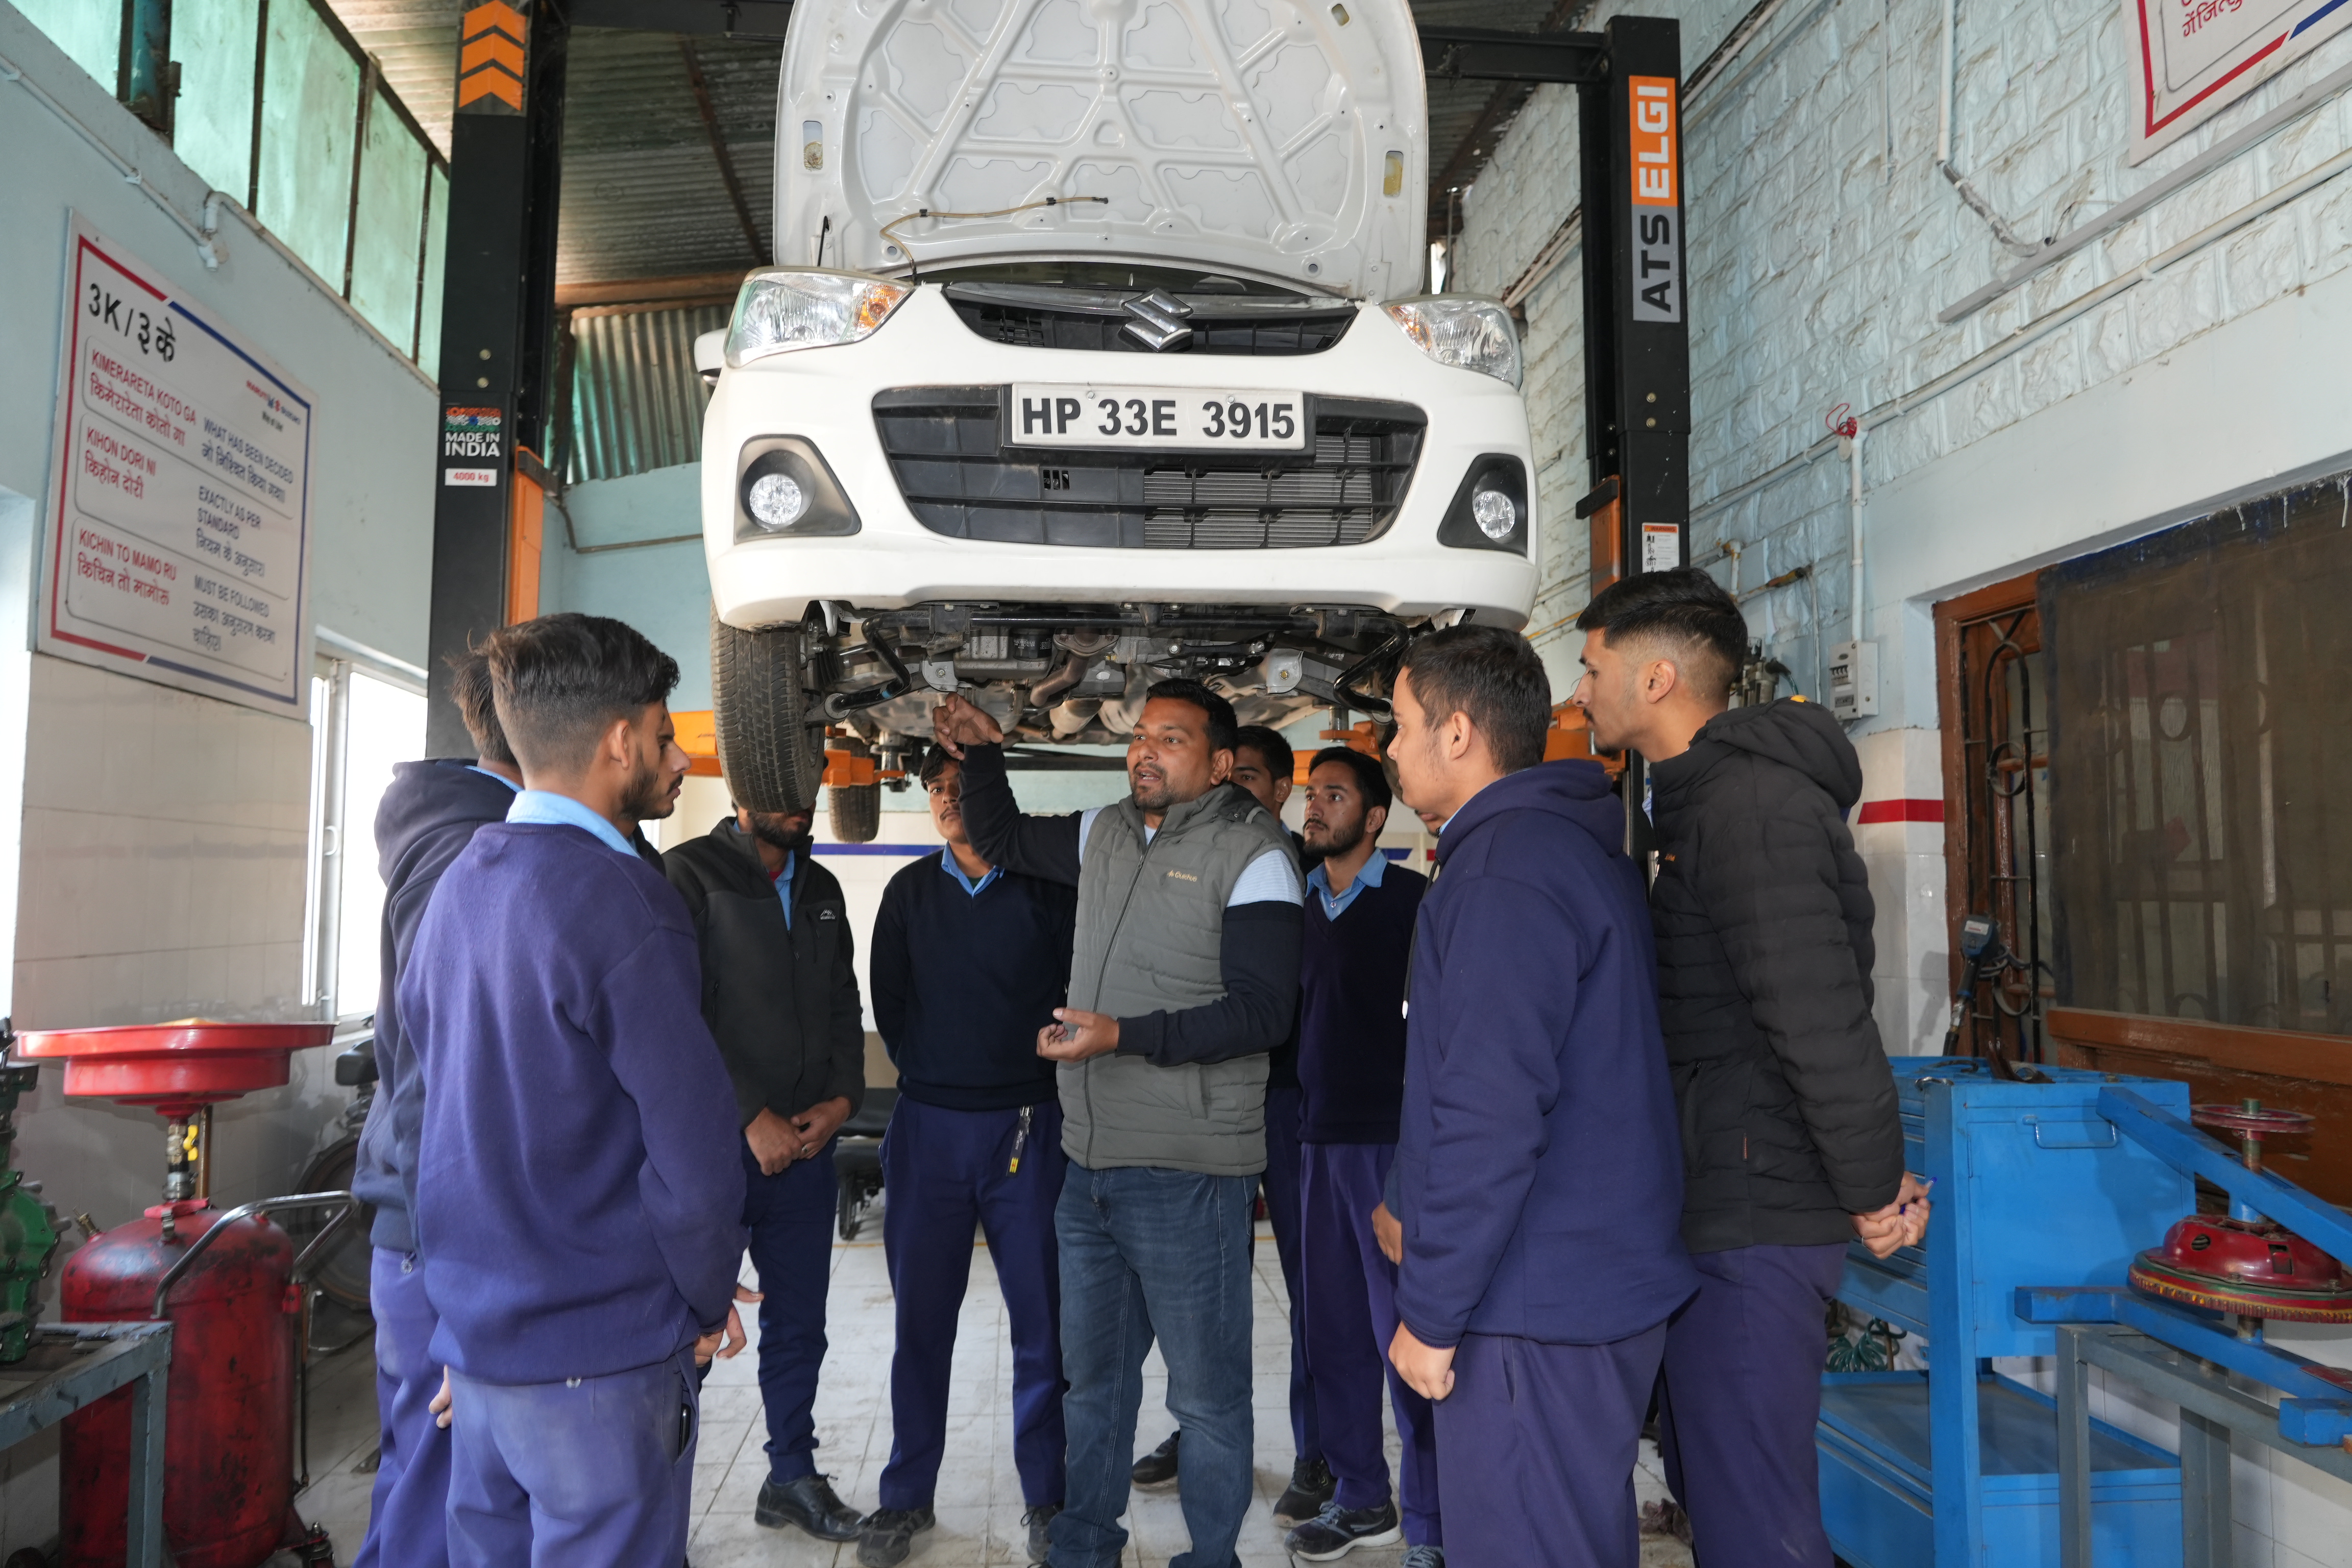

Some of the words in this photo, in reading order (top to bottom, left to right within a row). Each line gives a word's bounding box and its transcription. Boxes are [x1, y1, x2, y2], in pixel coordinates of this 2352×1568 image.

[1637, 86, 1670, 199] ELGI
[1640, 214, 1672, 313] ATS
[92, 348, 155, 401] KIMERARETA
[157, 388, 181, 416] KOTO
[184, 406, 196, 426] GA
[146, 408, 170, 438] कोतो
[174, 426, 186, 447] गा
[445, 432, 483, 443] MADE
[486, 432, 500, 443] IN
[1022, 397, 1082, 435] HP
[1097, 399, 1177, 436] 33E
[1202, 401, 1295, 439] 3915
[87, 427, 118, 458] KIHON
[120, 445, 144, 470] DORI
[146, 458, 156, 476] NI
[204, 416, 227, 443] WHAT
[228, 432, 243, 453] HAS
[244, 443, 264, 466] BEEN
[265, 456, 294, 484] DECIDED
[445, 443, 501, 457] INDIA
[85, 450, 120, 488] किहोन
[122, 469, 144, 500] दोरी
[453, 472, 475, 481] 4000
[478, 473, 489, 482] kg
[198, 507, 239, 540] STANDARD
[199, 486, 234, 516] EXACTLY
[235, 505, 245, 522] AS
[247, 511, 261, 530] PER
[78, 551, 115, 587] किचिन
[118, 567, 131, 594] तो
[79, 528, 115, 557] KICHIN
[116, 544, 130, 562] TO
[132, 550, 162, 575] MAMO
[164, 562, 177, 581] RU
[194, 575, 217, 597] MUST
[218, 585, 229, 602] BE
[230, 590, 270, 618] FOLLOWED
[1175, 871, 1197, 882] Quechua
